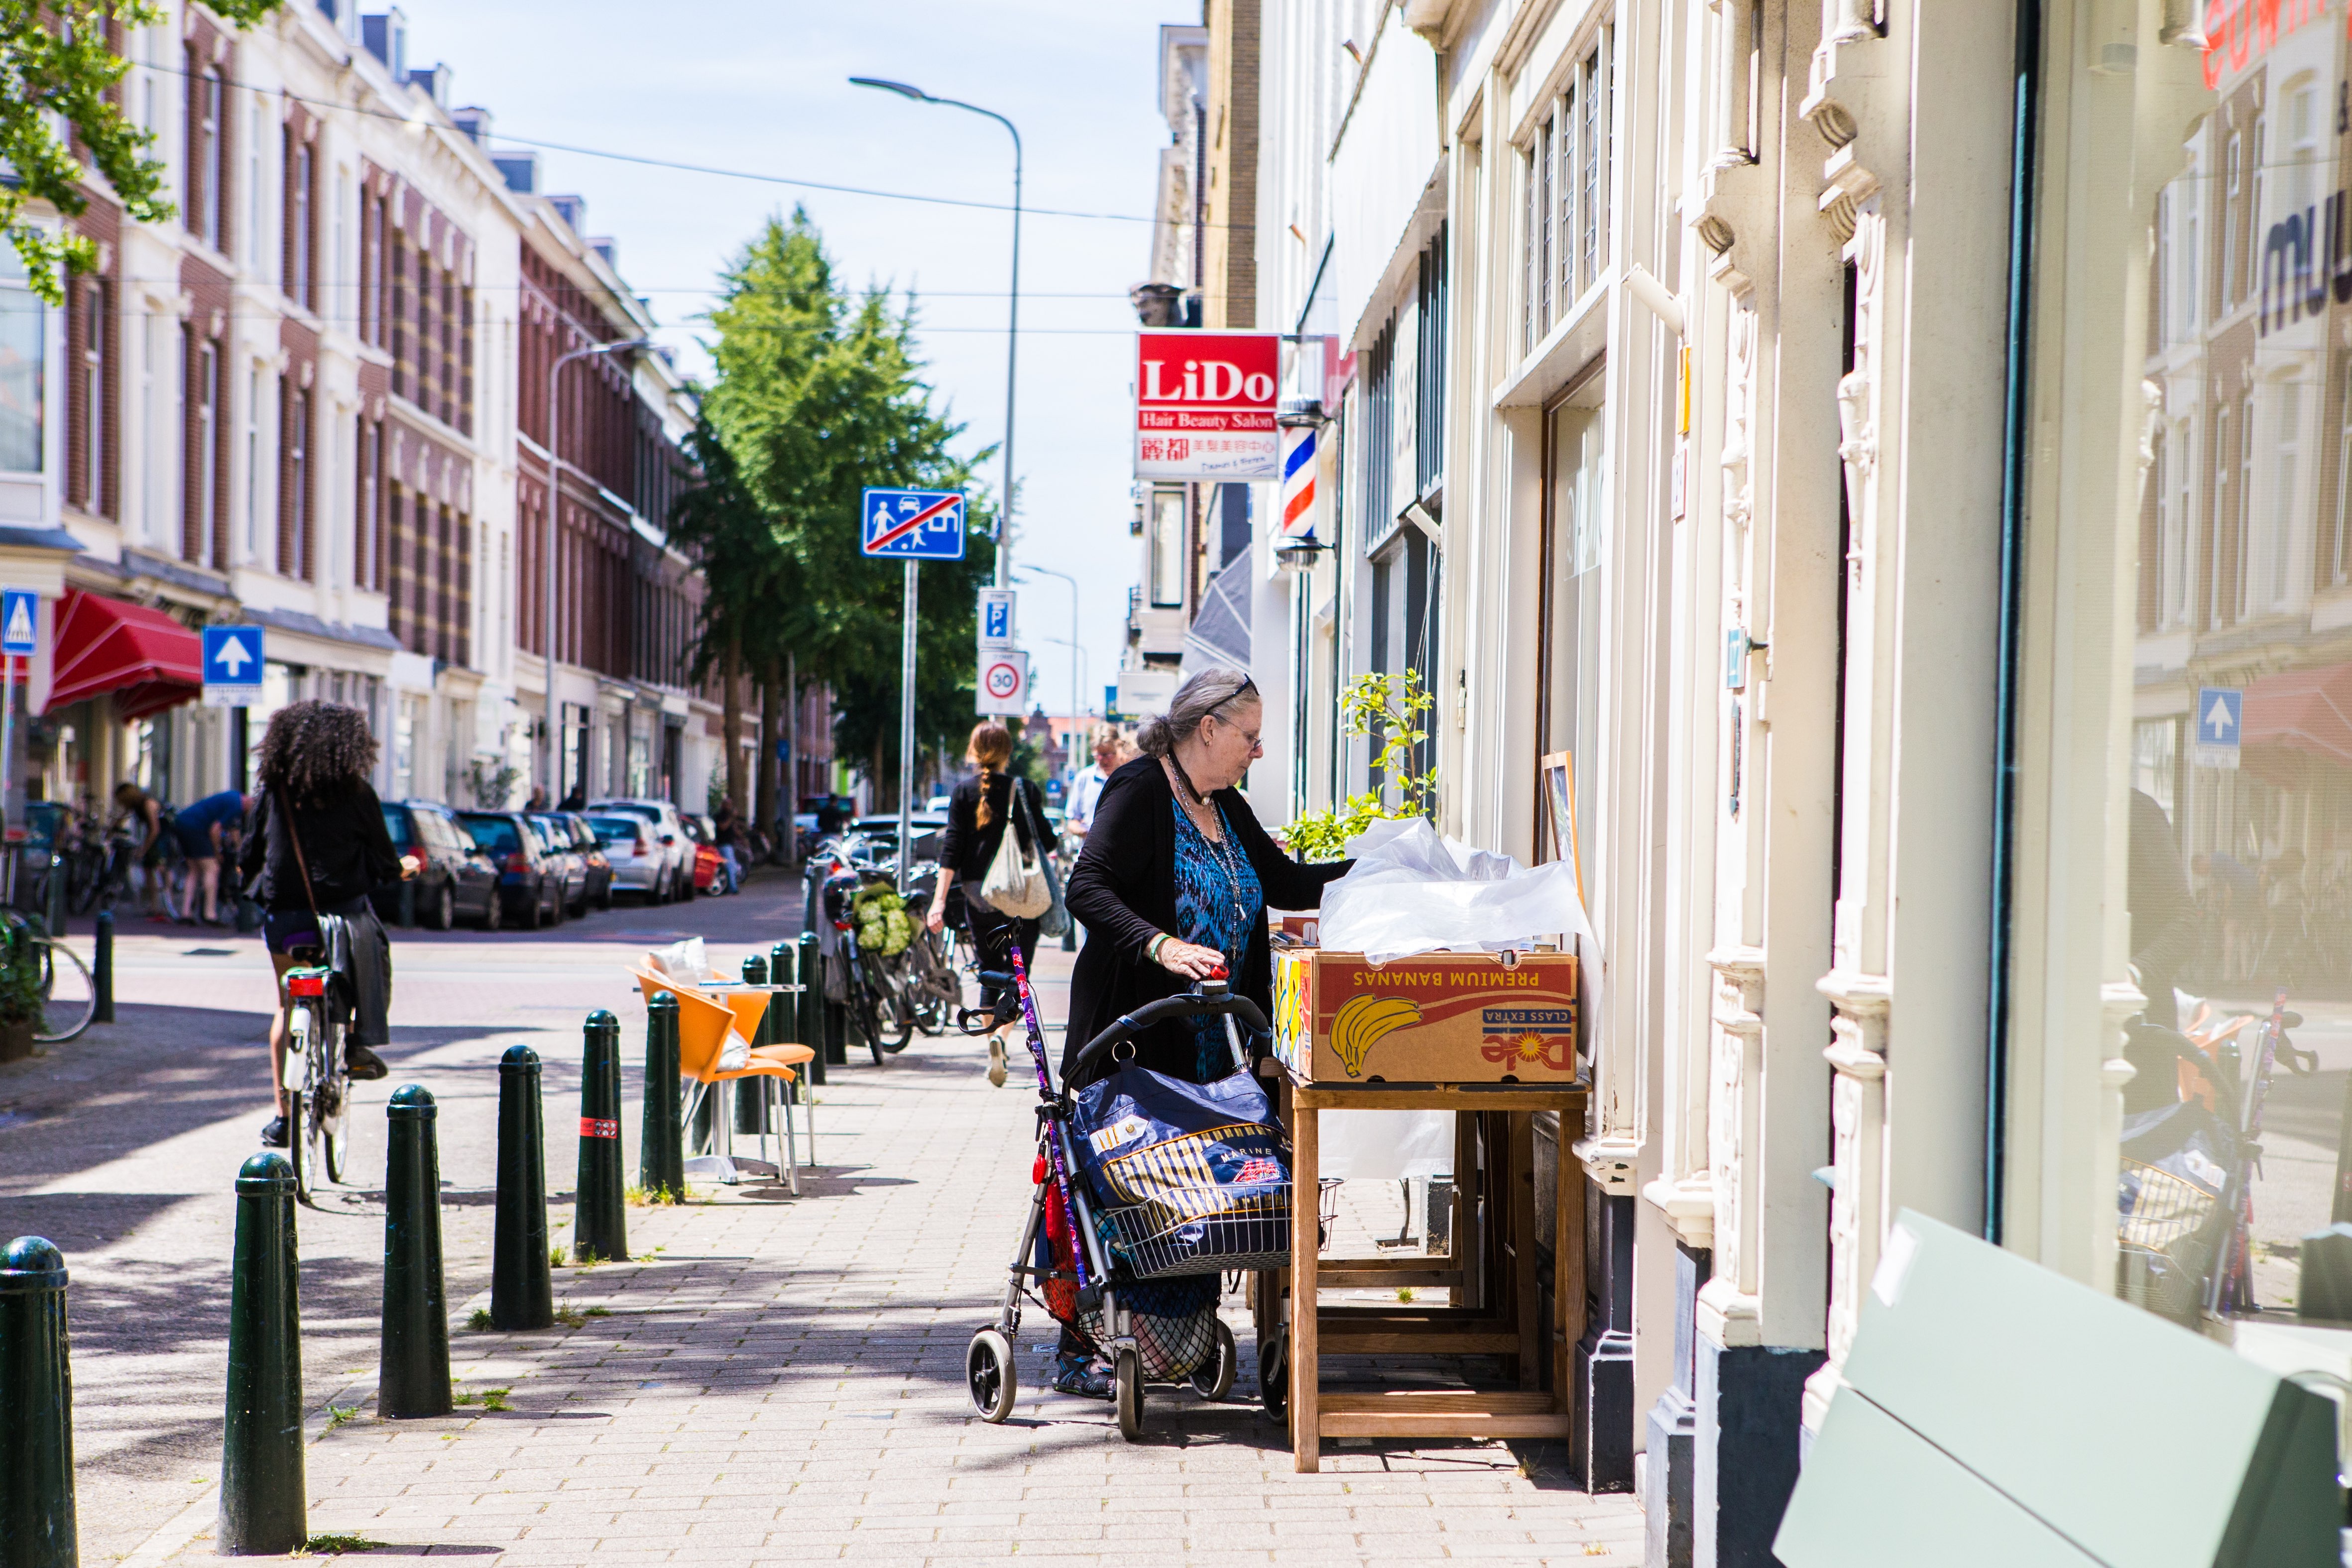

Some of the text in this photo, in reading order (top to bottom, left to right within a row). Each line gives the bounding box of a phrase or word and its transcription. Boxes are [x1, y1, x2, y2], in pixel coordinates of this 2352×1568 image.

[1142, 360, 1275, 402] LiDo
[1142, 412, 1273, 431] Hair Beauty Salon
[1140, 437, 1189, 461] 麗都
[991, 609, 1003, 625] P
[993, 674, 1013, 688] 30
[1353, 971, 1539, 986] PREMIUM BANANAS
[1486, 1012, 1568, 1021] CLASS EXTRA
[1481, 1031, 1571, 1072] Dole
[1221, 1147, 1273, 1163] MARINE
